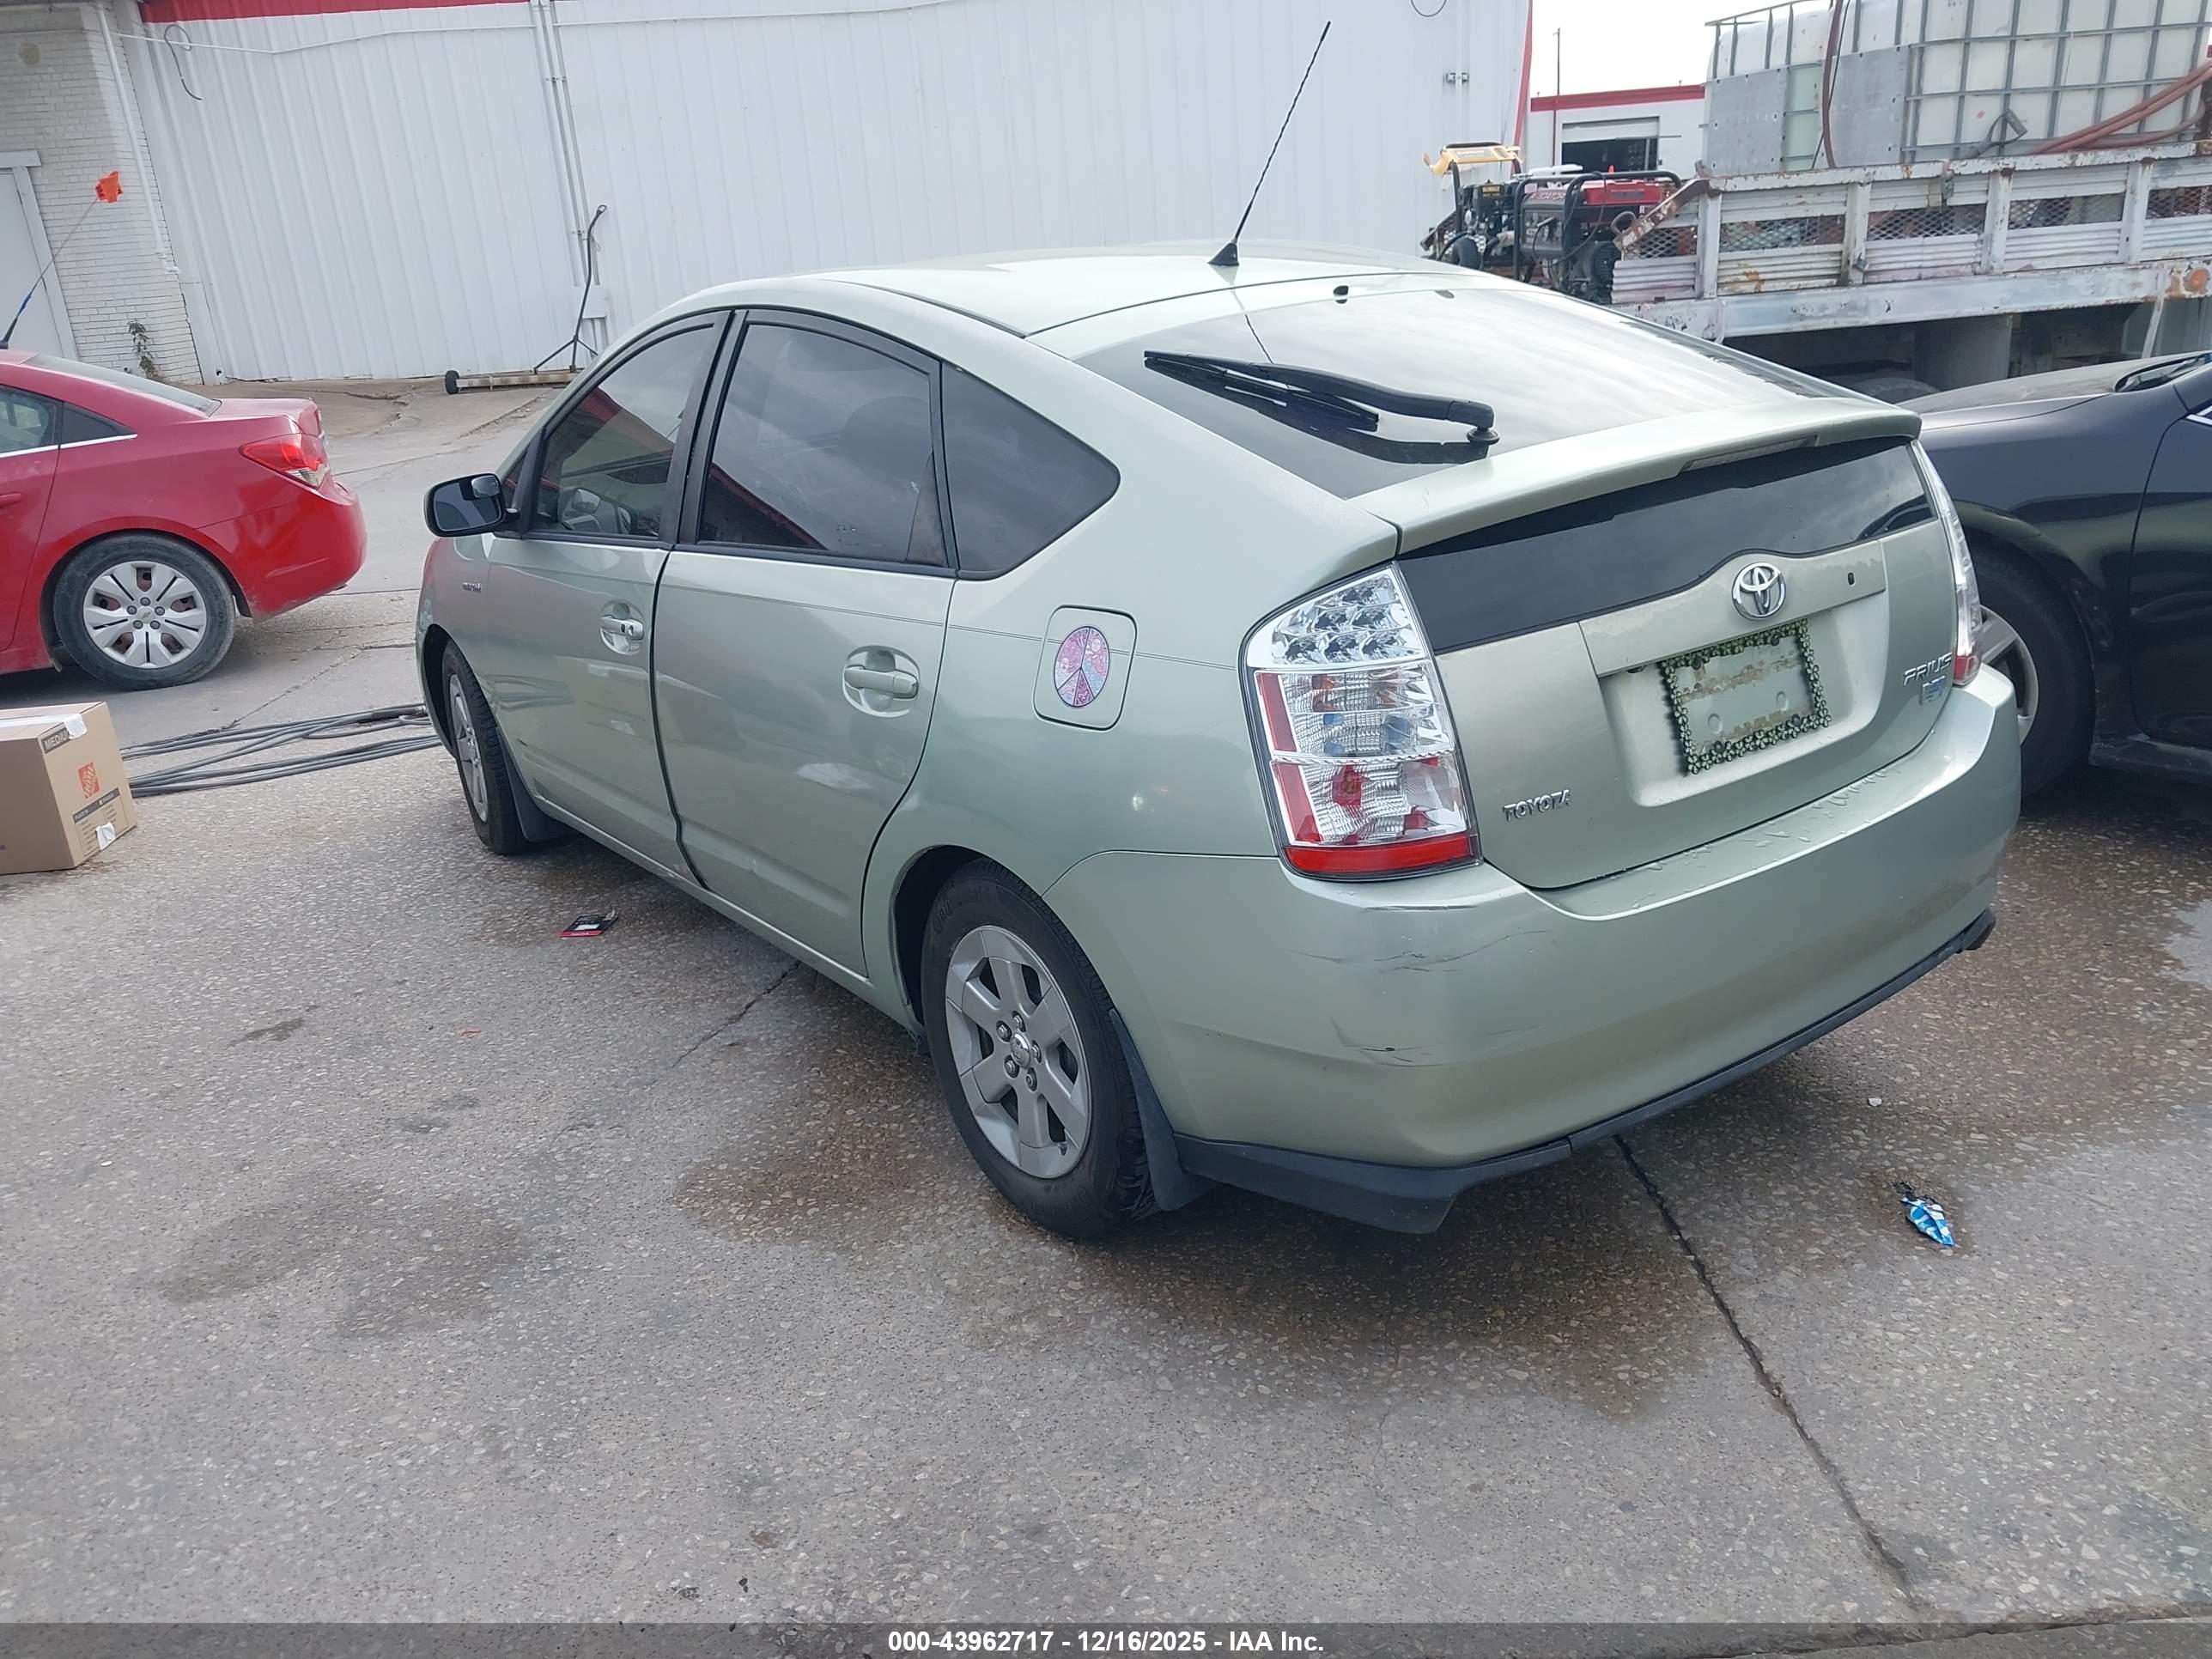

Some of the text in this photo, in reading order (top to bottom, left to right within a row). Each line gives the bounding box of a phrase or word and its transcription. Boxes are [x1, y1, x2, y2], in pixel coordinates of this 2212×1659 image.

[1903, 652, 1953, 686] PRIUS
[44, 730, 70, 750] MEDIU
[1503, 788, 1571, 822] TOYOTA
